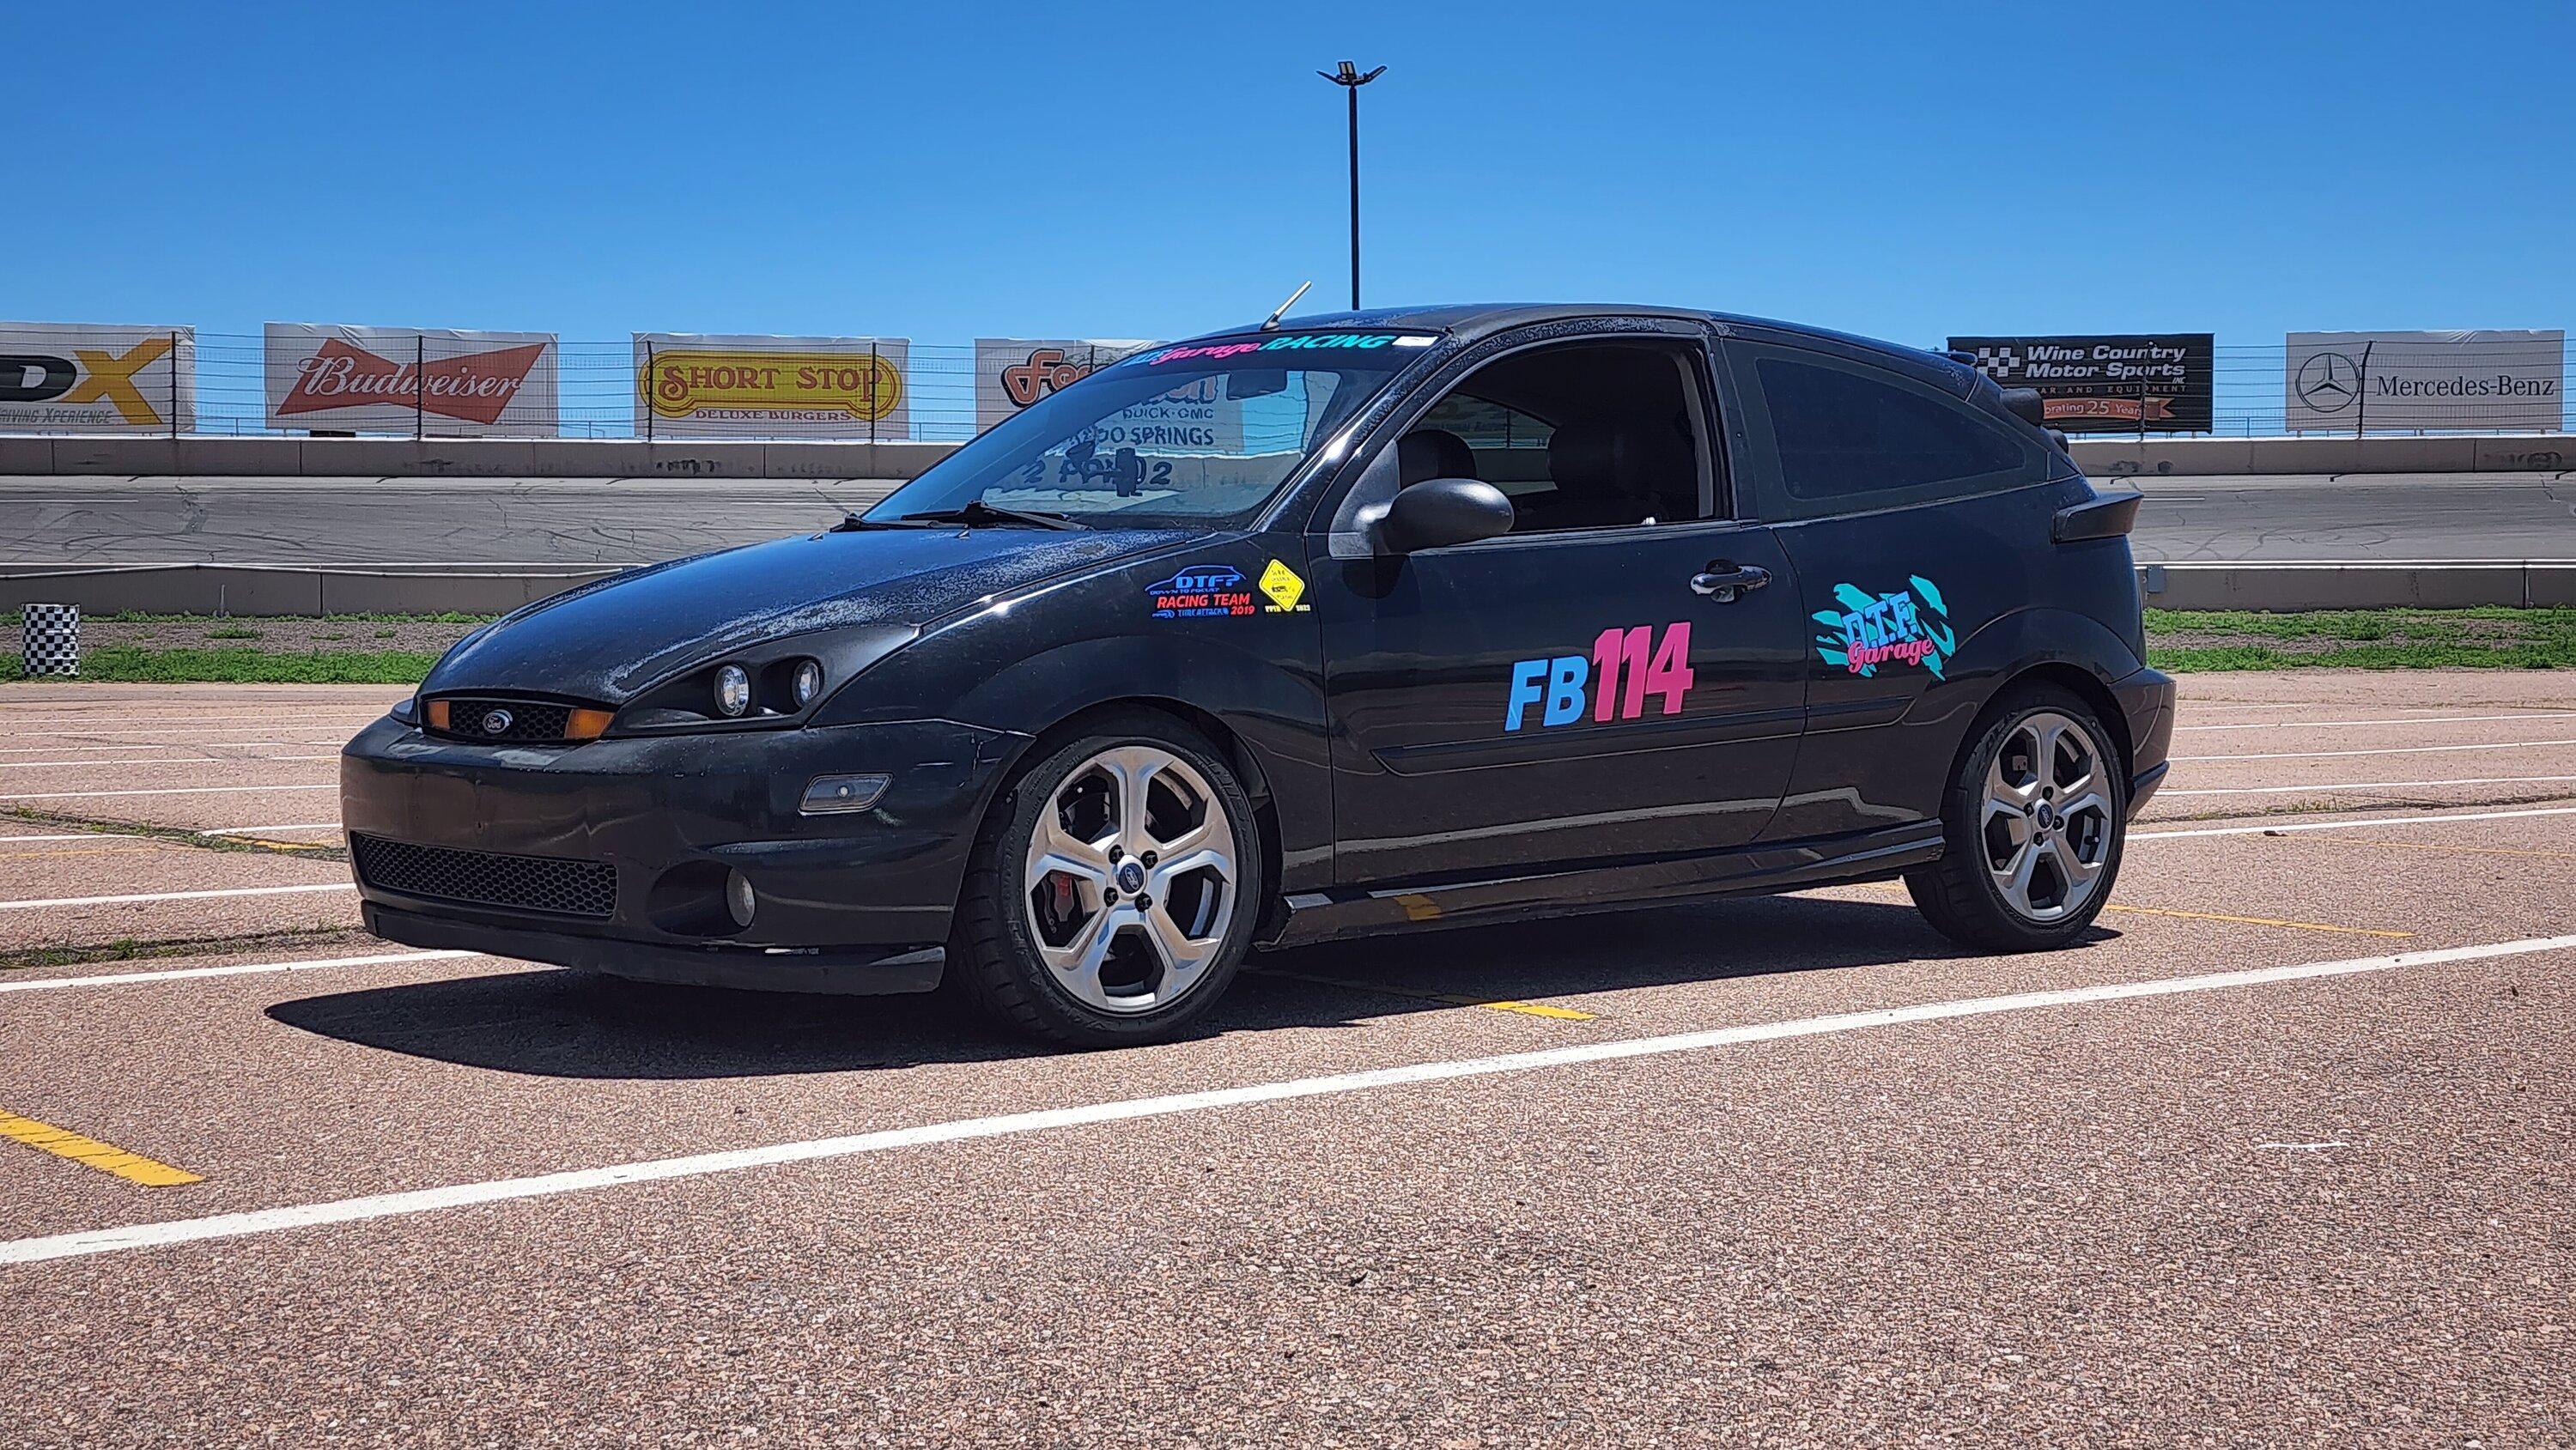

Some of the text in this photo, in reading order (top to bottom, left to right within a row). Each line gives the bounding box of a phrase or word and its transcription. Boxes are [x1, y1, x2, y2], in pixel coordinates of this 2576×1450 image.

[2027, 345, 2186, 363] Wine Country
[296, 355, 521, 397] Budweiser
[2025, 361, 2185, 380] Motor Sports
[658, 366, 883, 402] SHORT STOP
[2376, 374, 2555, 397] Mercedes-Benz
[42, 409, 113, 423] XPERIENCE
[696, 410, 853, 422] DELUXE BURGERS
[1178, 407, 1214, 419] GMC
[2087, 400, 2110, 416] 25
[1130, 426, 1214, 446] SPRINGS
[1176, 573, 1241, 589] DTF?
[1157, 592, 1251, 609] RACING TEAM
[1230, 605, 1255, 616] 2019
[1848, 639, 1935, 674] Garage
